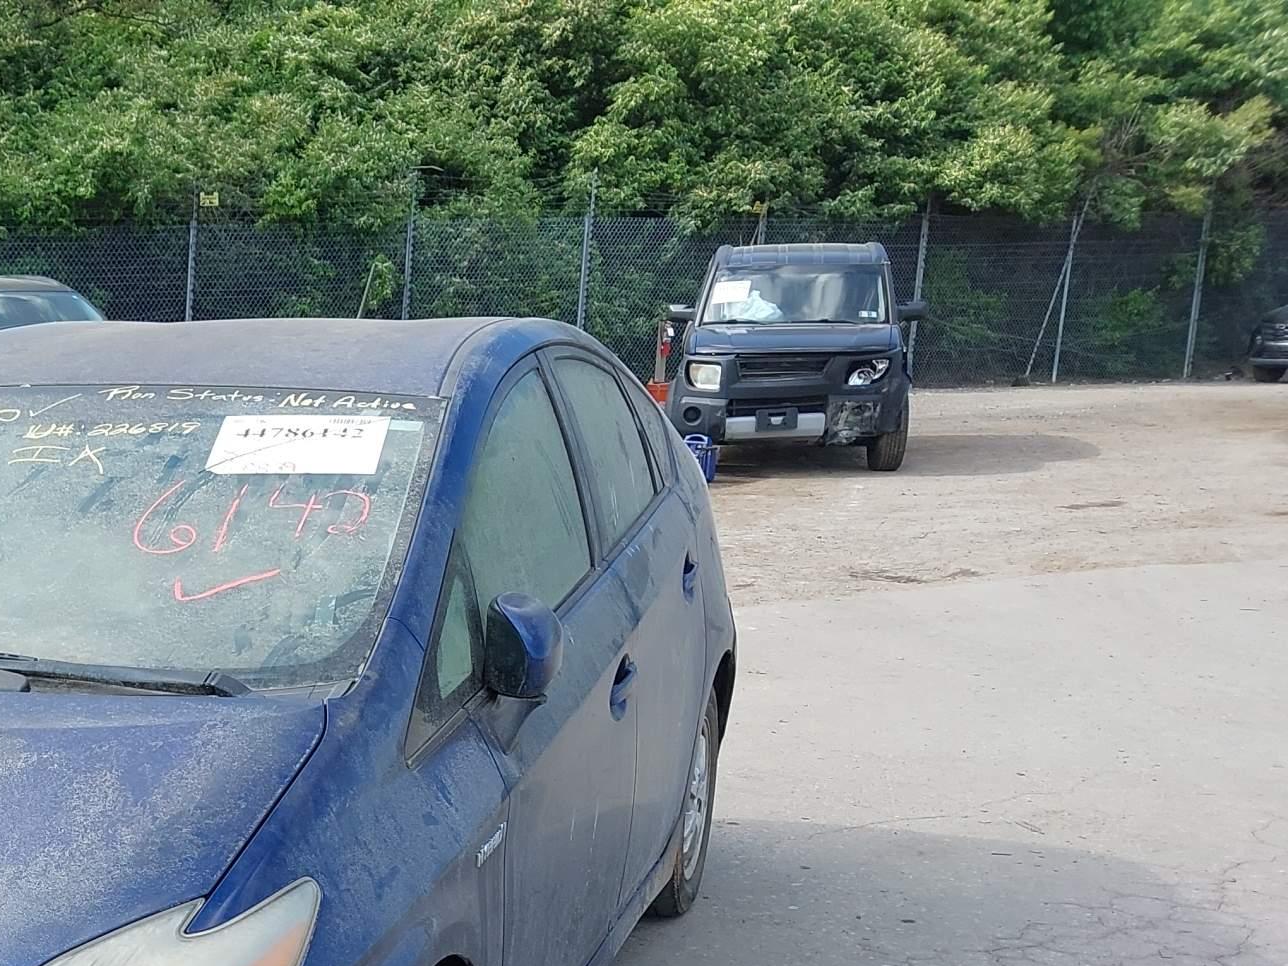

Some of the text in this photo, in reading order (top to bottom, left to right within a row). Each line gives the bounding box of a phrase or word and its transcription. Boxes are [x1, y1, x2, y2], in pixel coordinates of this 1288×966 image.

[278, 392, 327, 408] Not
[332, 395, 417, 410] Active
[87, 422, 201, 438] 226819
[133, 479, 371, 554] 6142
